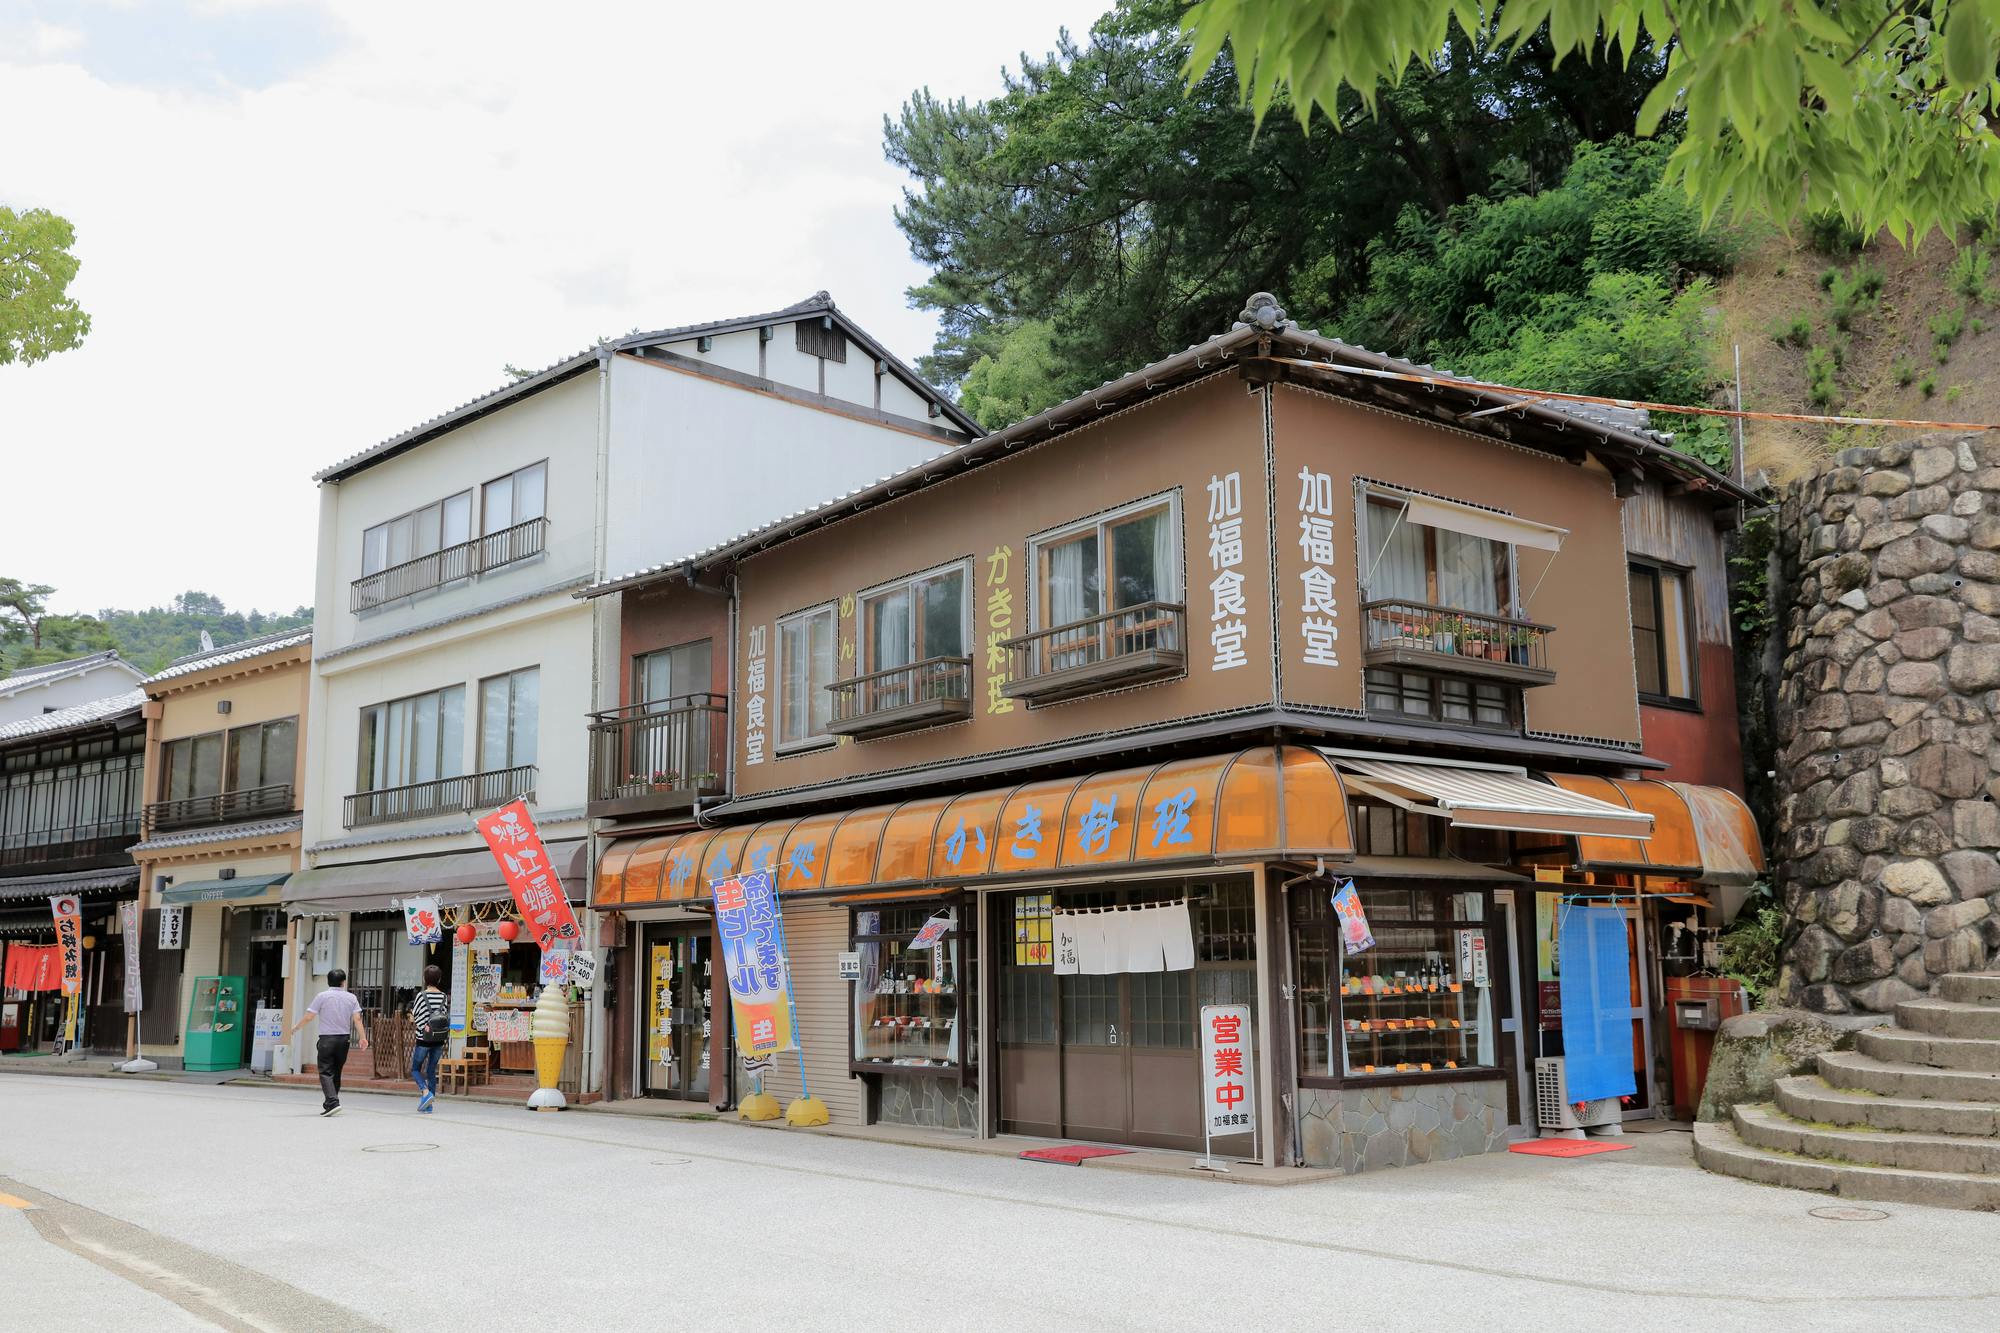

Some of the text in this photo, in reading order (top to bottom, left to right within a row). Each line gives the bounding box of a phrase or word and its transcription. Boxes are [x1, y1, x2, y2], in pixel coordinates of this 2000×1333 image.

[1206, 471, 1248, 672] 加福食堂
[1298, 465, 1339, 667] 加福食堂
[746, 625, 766, 766] 加福食堂
[945, 787, 1198, 865] かき料理
[170, 914, 180, 947] えびすや
[1029, 944, 1047, 960] 480
[1060, 932, 1076, 965] 加福
[1109, 1024, 1116, 1044] 入口
[1212, 1014, 1244, 1111] 営業中
[1213, 1113, 1249, 1127] 加福食堂
